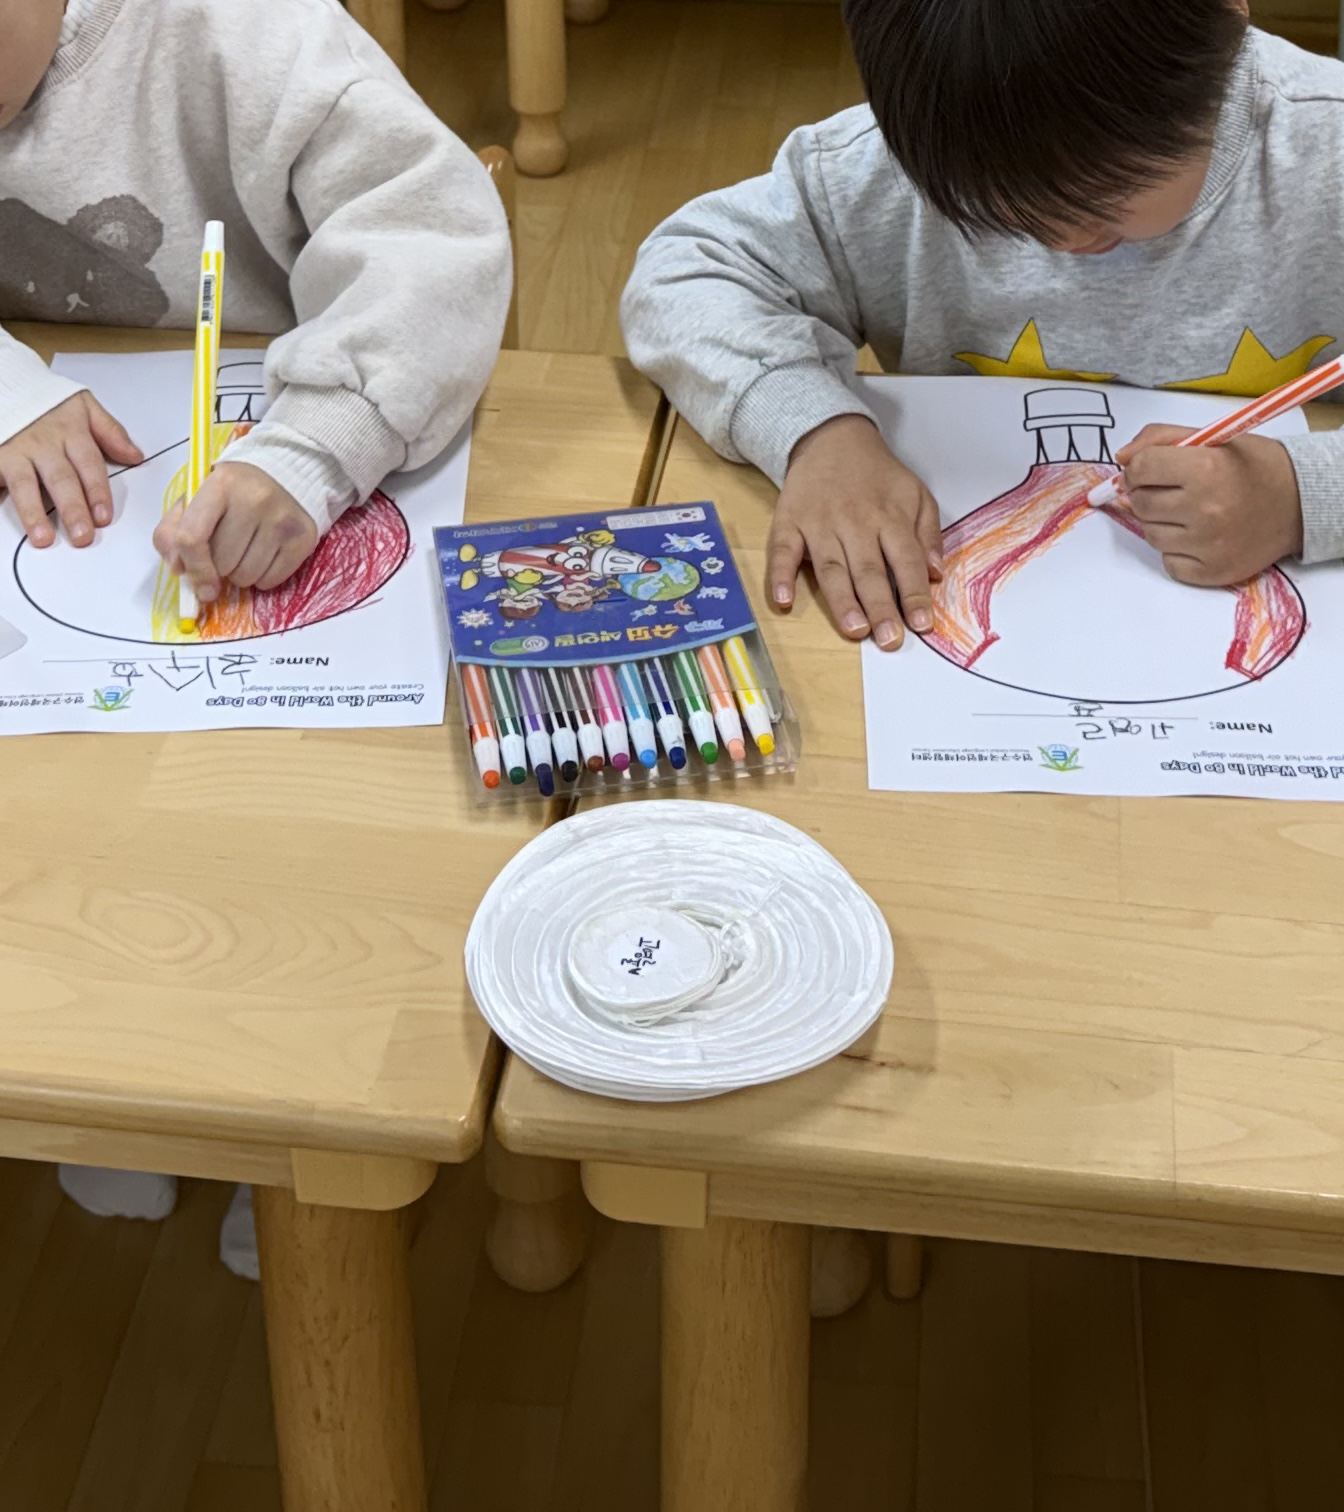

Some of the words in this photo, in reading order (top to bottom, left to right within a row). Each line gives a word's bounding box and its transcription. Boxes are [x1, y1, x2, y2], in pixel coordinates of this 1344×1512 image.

[270, 656, 329, 666] Name:
[206, 695, 245, 707] Days
[270, 695, 287, 707] in
[289, 695, 334, 707] World
[337, 695, 364, 707] the
[367, 693, 425, 707] Around
[1209, 721, 1273, 733] Name:
[1160, 760, 1202, 774] Days
[1228, 762, 1245, 775] in
[1249, 764, 1297, 777] World
[1298, 765, 1328, 778] the
